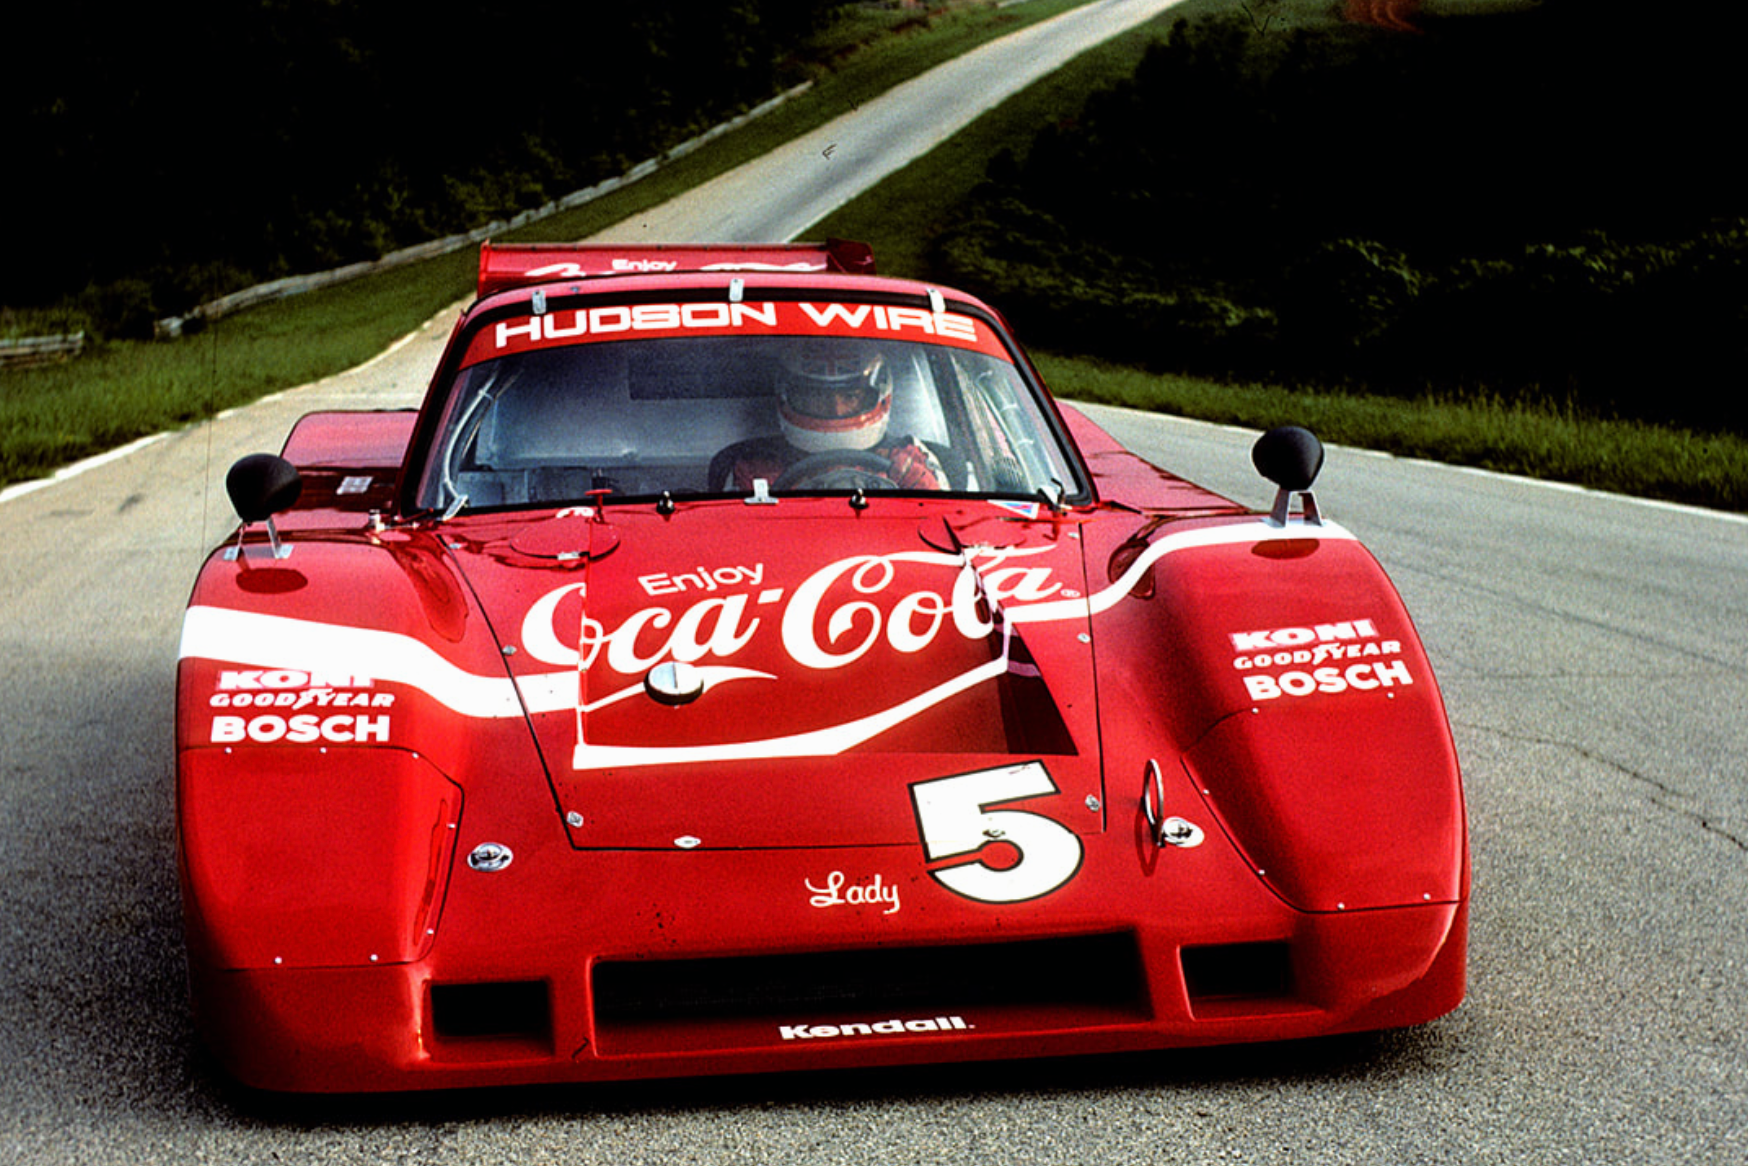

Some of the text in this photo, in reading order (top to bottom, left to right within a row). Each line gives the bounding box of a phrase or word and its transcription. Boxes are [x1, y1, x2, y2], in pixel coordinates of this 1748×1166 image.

[612, 258, 678, 272] Enjoy
[494, 303, 978, 348] HUDSON WIRE
[637, 562, 765, 597] Enjoy
[1229, 618, 1379, 652] KONI
[1233, 640, 1402, 670] GOODYEAR
[1243, 660, 1414, 701] BOSCH
[209, 688, 395, 710] GOODYEAR
[210, 714, 391, 744] BOSCH
[907, 759, 1085, 905] 5
[804, 870, 901, 915] Lady
